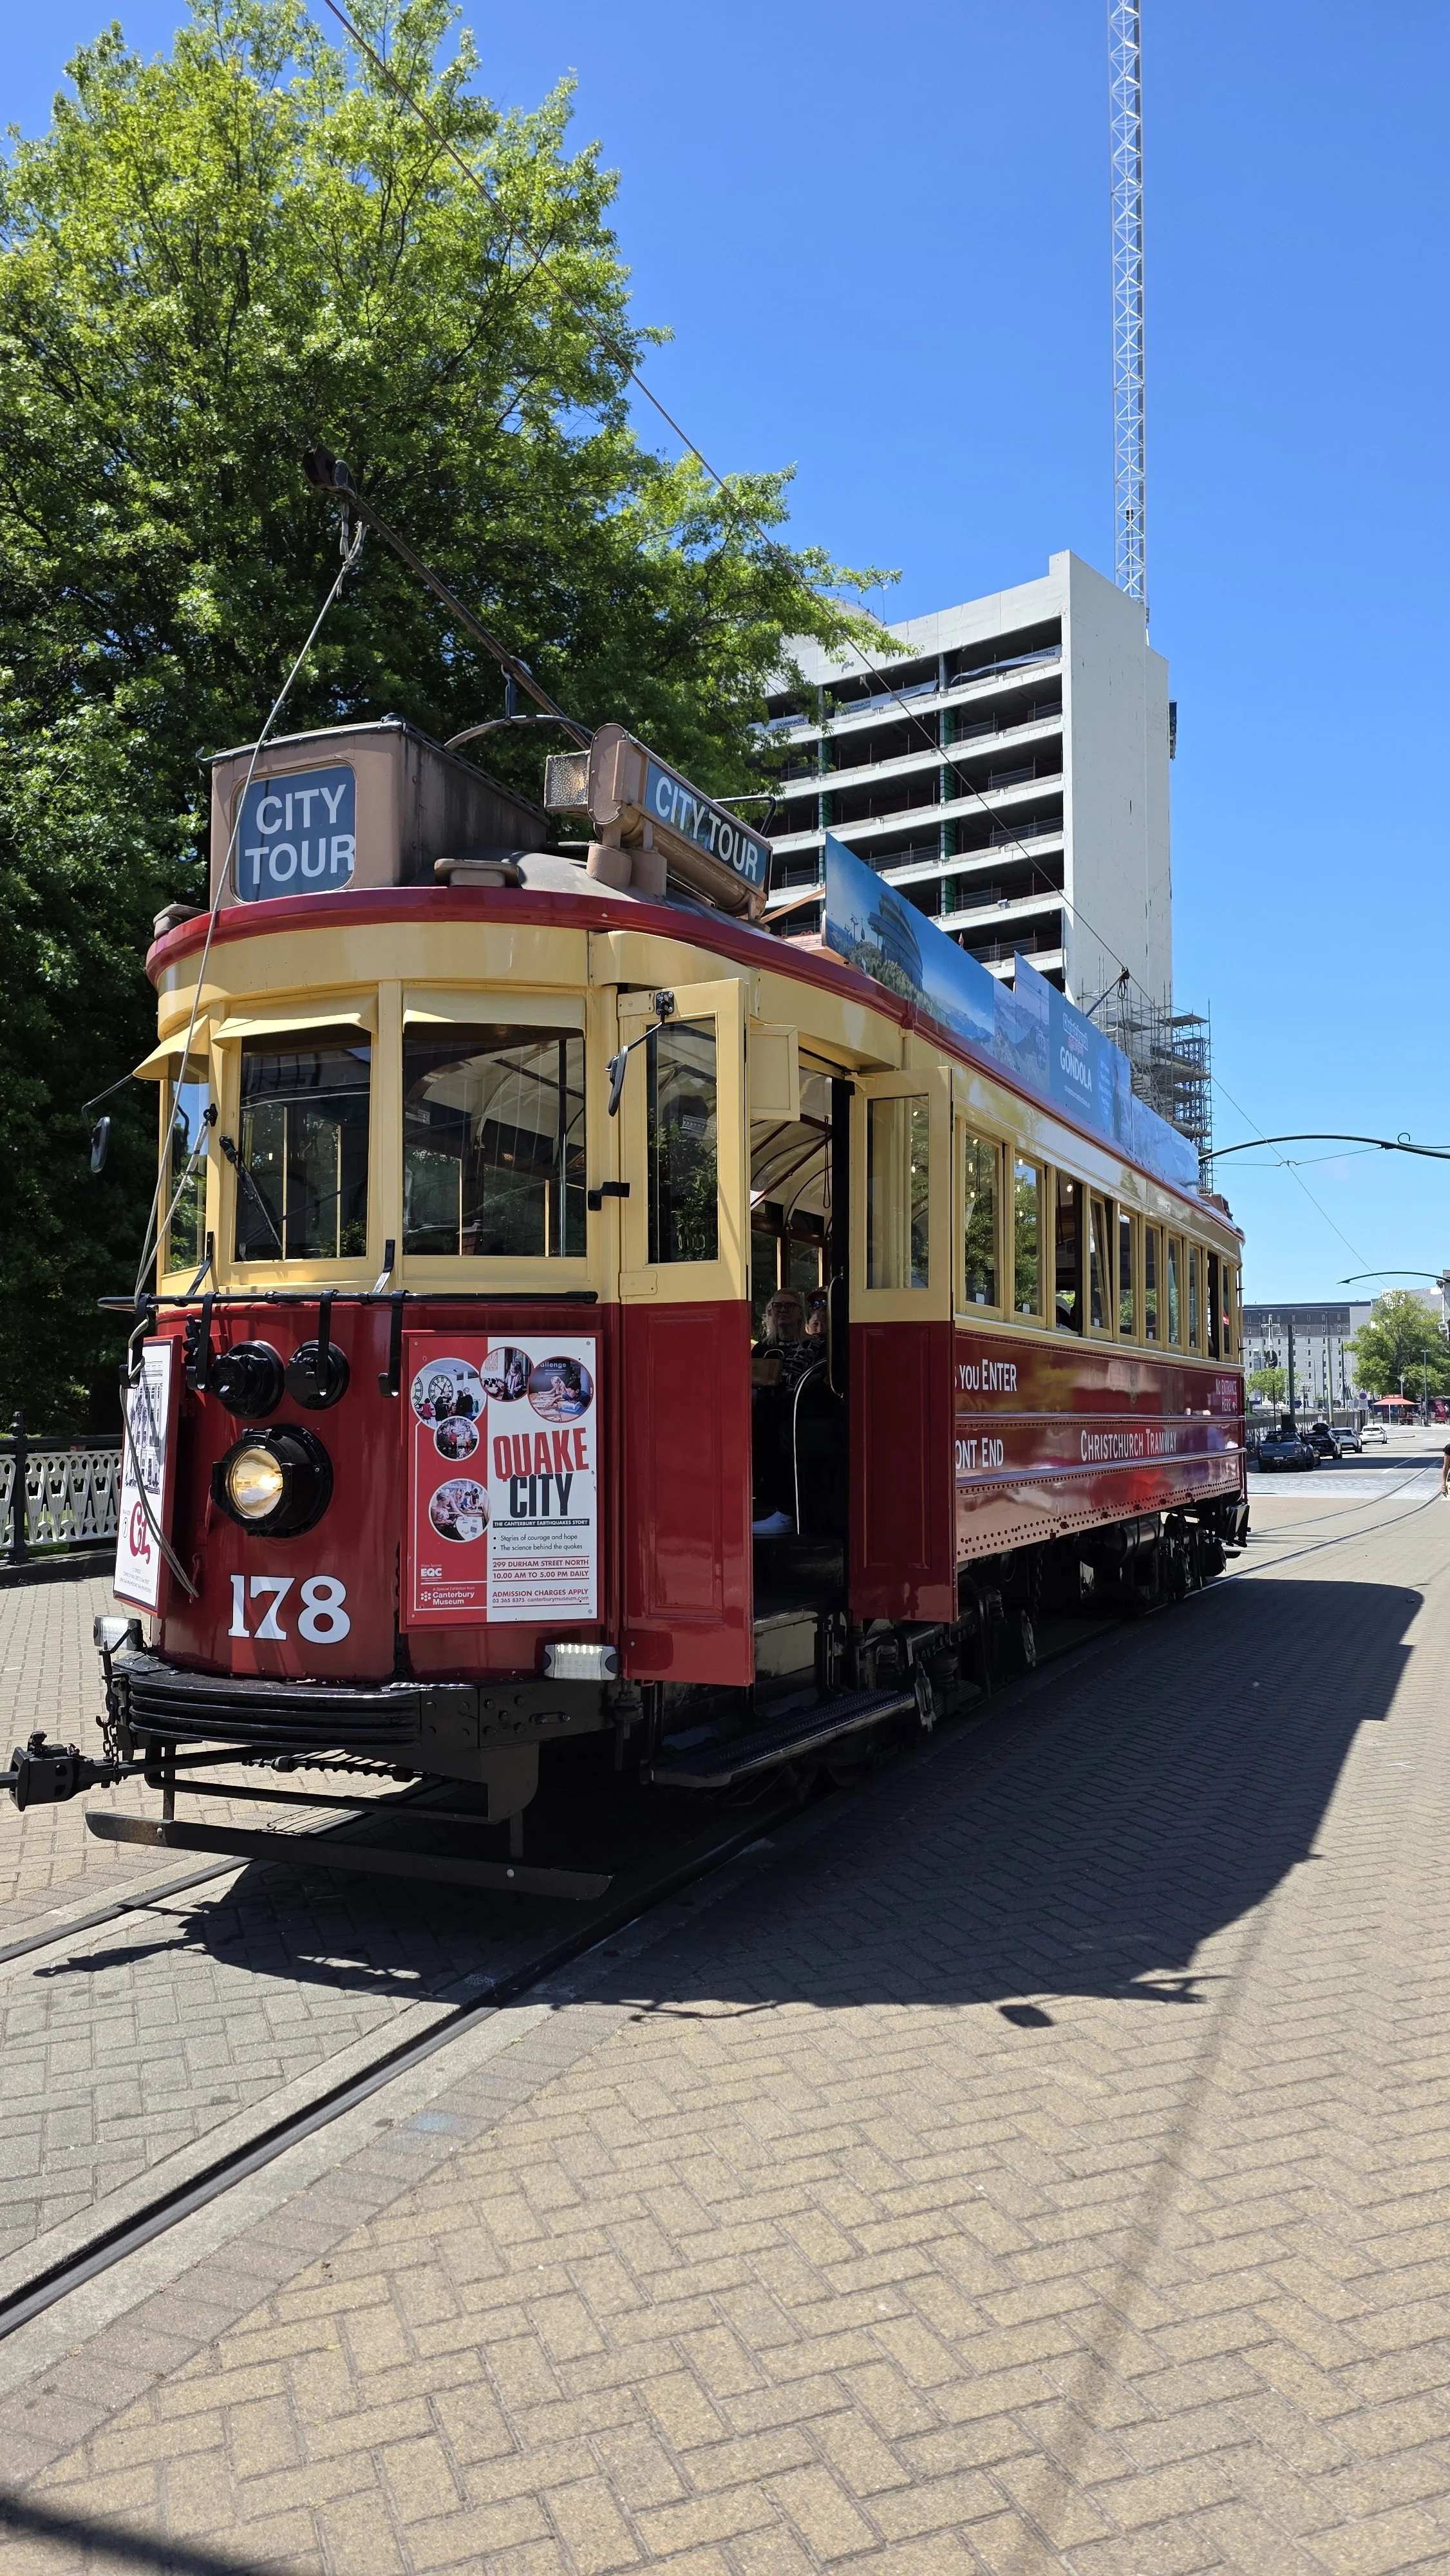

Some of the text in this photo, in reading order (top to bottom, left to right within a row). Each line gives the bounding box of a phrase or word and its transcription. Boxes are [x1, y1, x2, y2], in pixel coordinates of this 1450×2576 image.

[777, 719, 805, 728] DOMINION
[256, 784, 346, 835] CITY
[655, 776, 758, 882] CITY TOUR
[245, 834, 355, 885] TOUR
[1060, 1045, 1093, 1093] GONDOLA
[541, 1360, 567, 1369] allenge
[959, 1365, 979, 1390] YOU
[982, 1358, 1017, 1392] ENTER
[493, 1427, 589, 1482] QUAKE
[955, 1437, 1004, 1470] ONT END
[1080, 1428, 1177, 1462] CHRISTCHURCH TRAMWAY
[509, 1473, 573, 1519] CITY
[421, 1567, 442, 1577] EQC
[228, 1574, 351, 1644] 178
